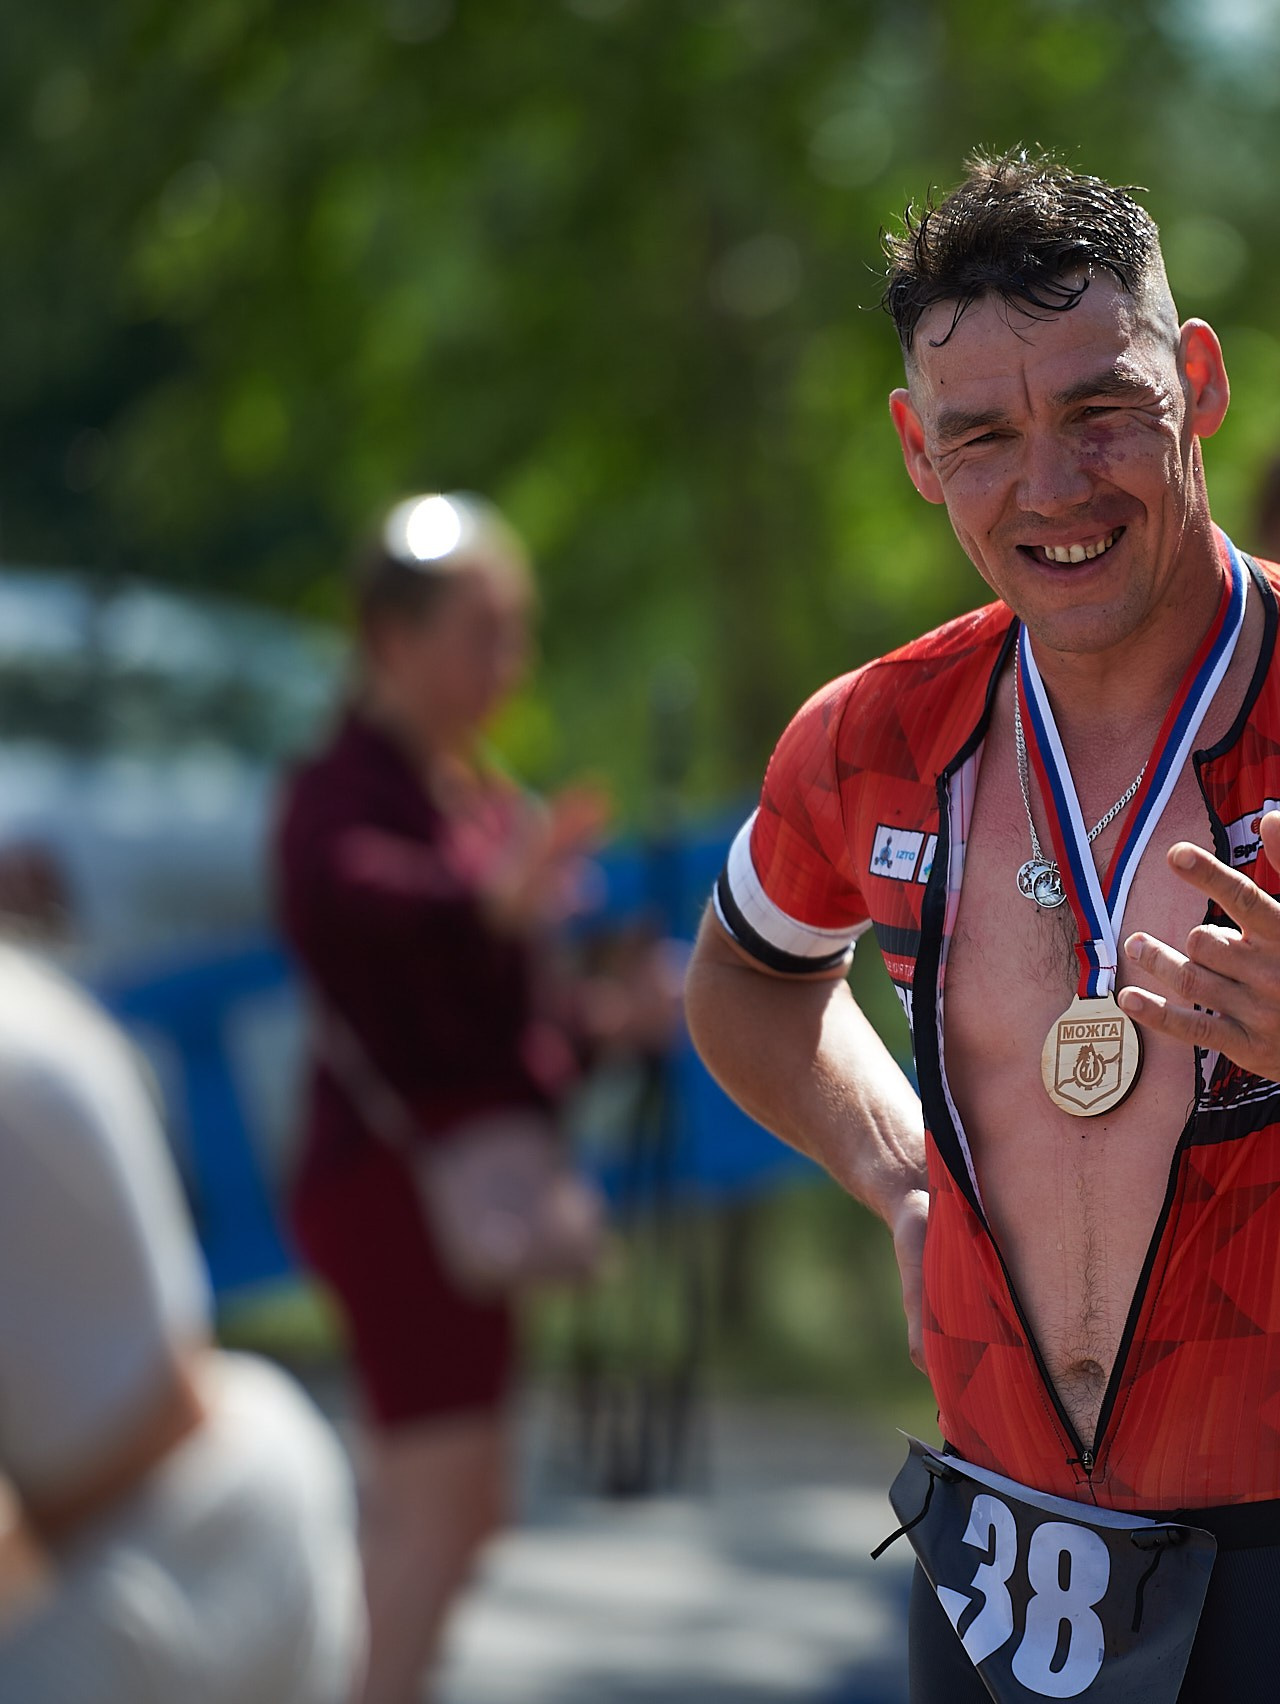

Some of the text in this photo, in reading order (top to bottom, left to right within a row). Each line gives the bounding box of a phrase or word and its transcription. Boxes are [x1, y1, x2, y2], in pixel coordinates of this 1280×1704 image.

[1233, 838, 1262, 858] Spr
[1062, 1023, 1119, 1040] МОЖГА
[936, 1494, 1111, 1699] 38
